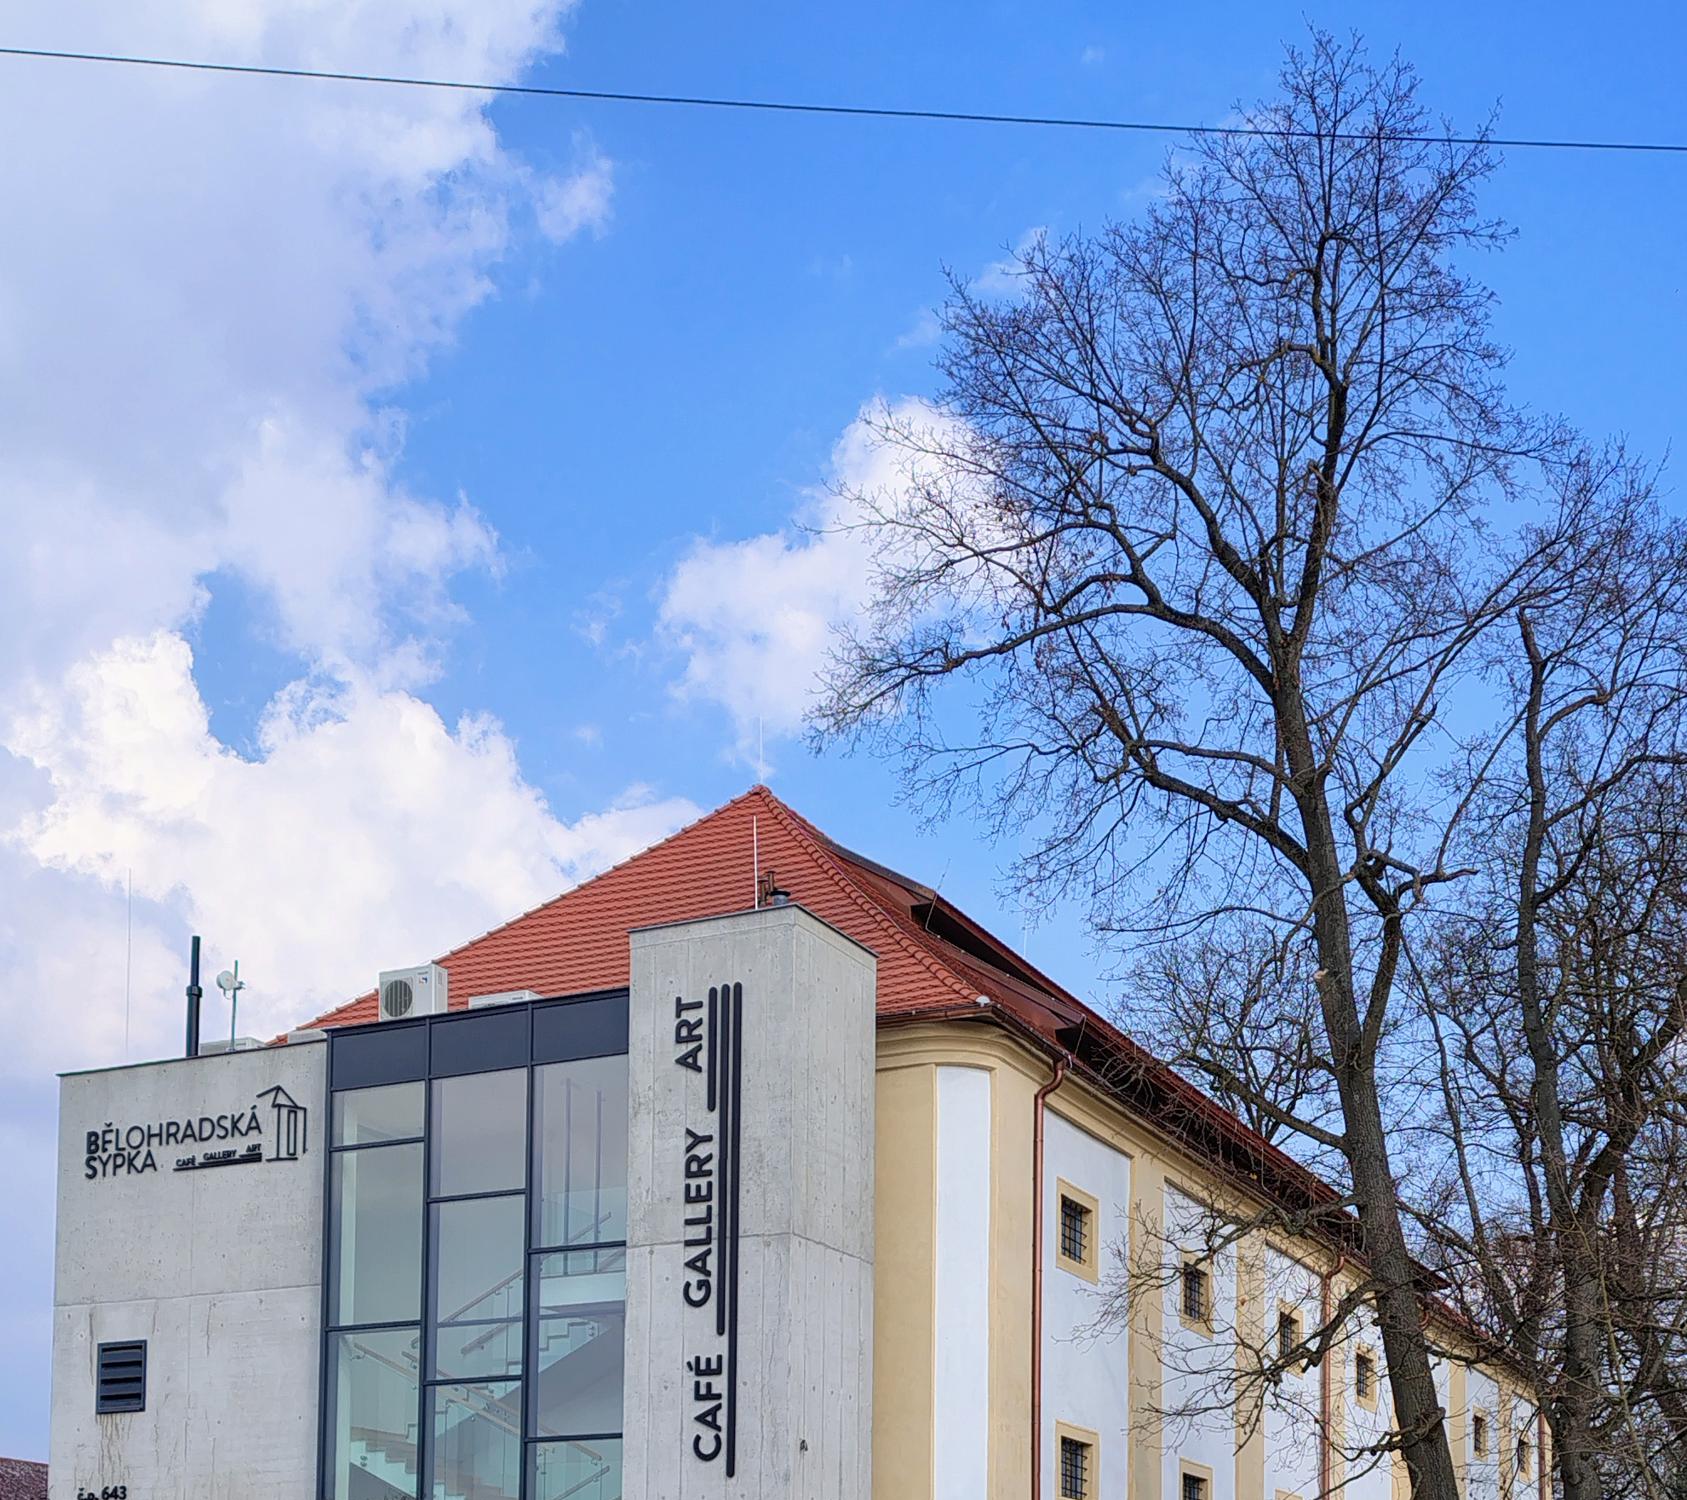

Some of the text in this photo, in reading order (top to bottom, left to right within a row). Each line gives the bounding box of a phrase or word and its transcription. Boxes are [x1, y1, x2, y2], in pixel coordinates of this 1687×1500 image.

[86, 1104, 262, 1155] BĚLOHRADSKÁ
[85, 1149, 158, 1180] SYPKA
[175, 1143, 262, 1167] CAFÉ GALLERY ART
[674, 996, 723, 1462] CAFÉ GALLERY ART
[101, 1485, 127, 1500] 643
